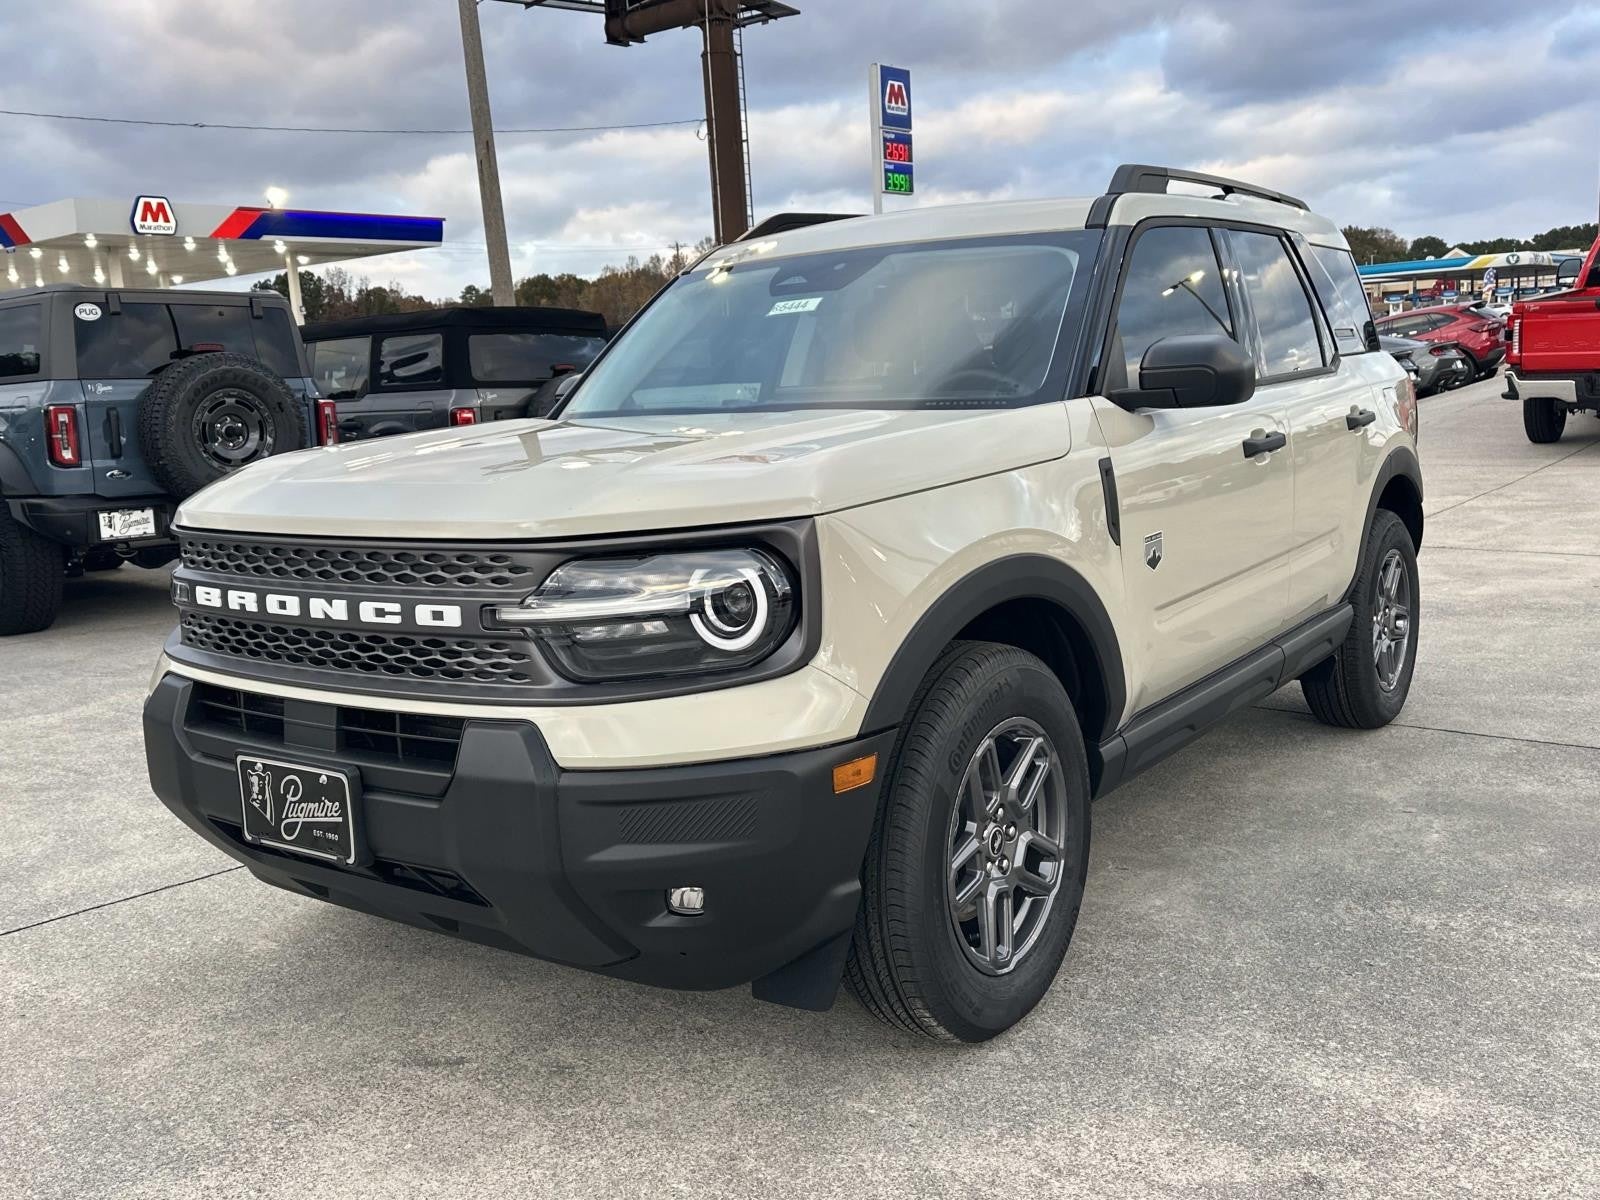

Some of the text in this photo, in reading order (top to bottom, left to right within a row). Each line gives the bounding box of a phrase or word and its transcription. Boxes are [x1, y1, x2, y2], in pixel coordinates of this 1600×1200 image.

[888, 83, 906, 106] M
[140, 201, 170, 223] M
[139, 223, 173, 231] Marathon
[79, 308, 99, 316] PUG
[195, 585, 462, 628] BRONCO
[281, 774, 343, 840] Pugmire
